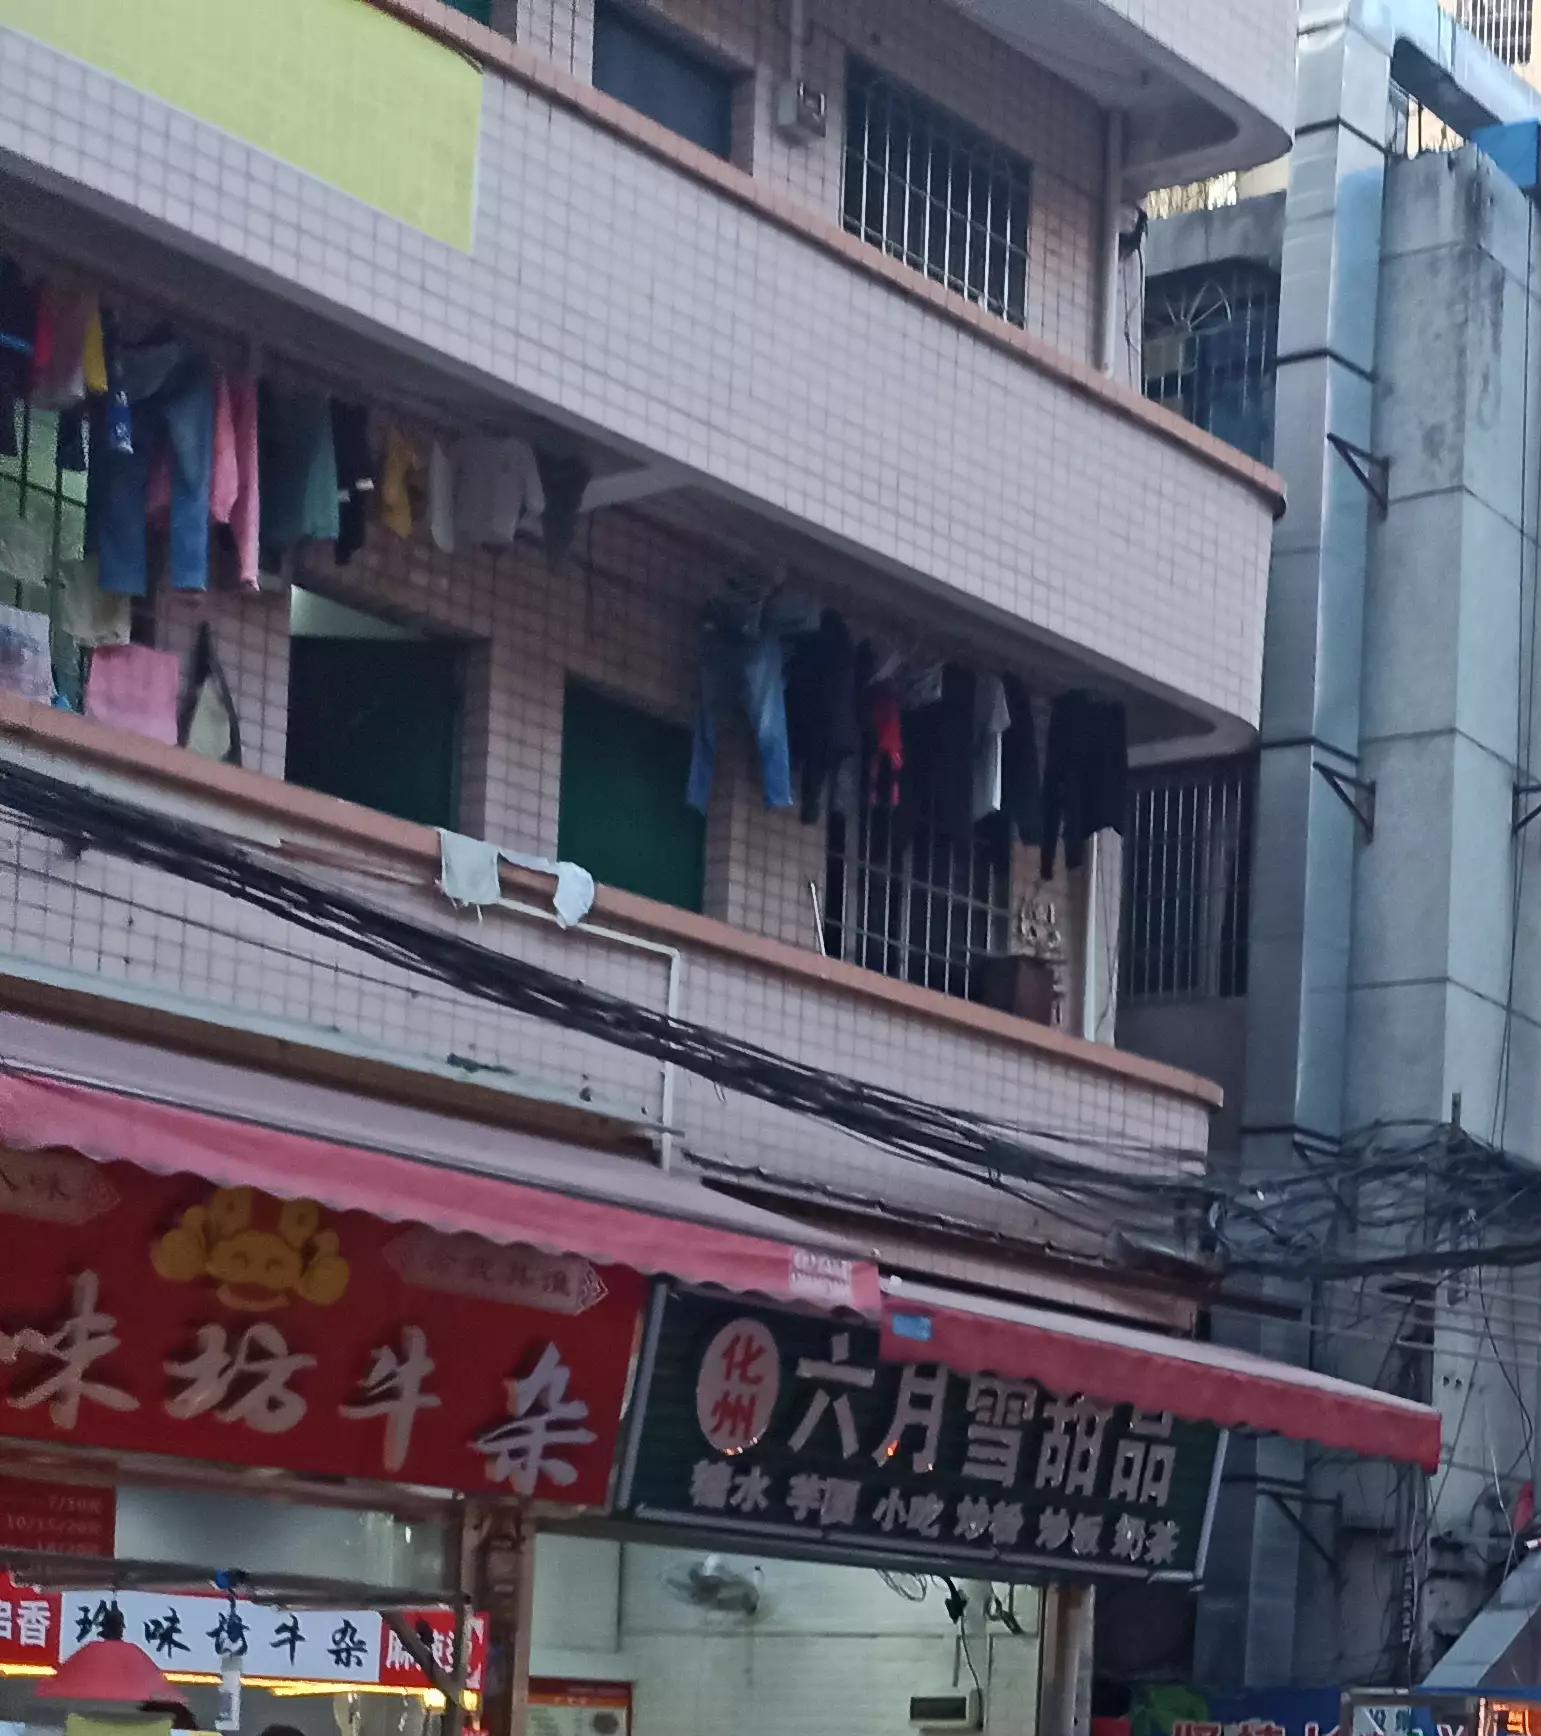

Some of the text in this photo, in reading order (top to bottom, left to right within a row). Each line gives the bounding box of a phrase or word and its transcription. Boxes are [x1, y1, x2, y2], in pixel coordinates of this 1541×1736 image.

[712, 1332, 766, 1442] 化州
[788, 1332, 1180, 1507] 六月雪甜品
[872, 1487, 944, 1537] 小吃
